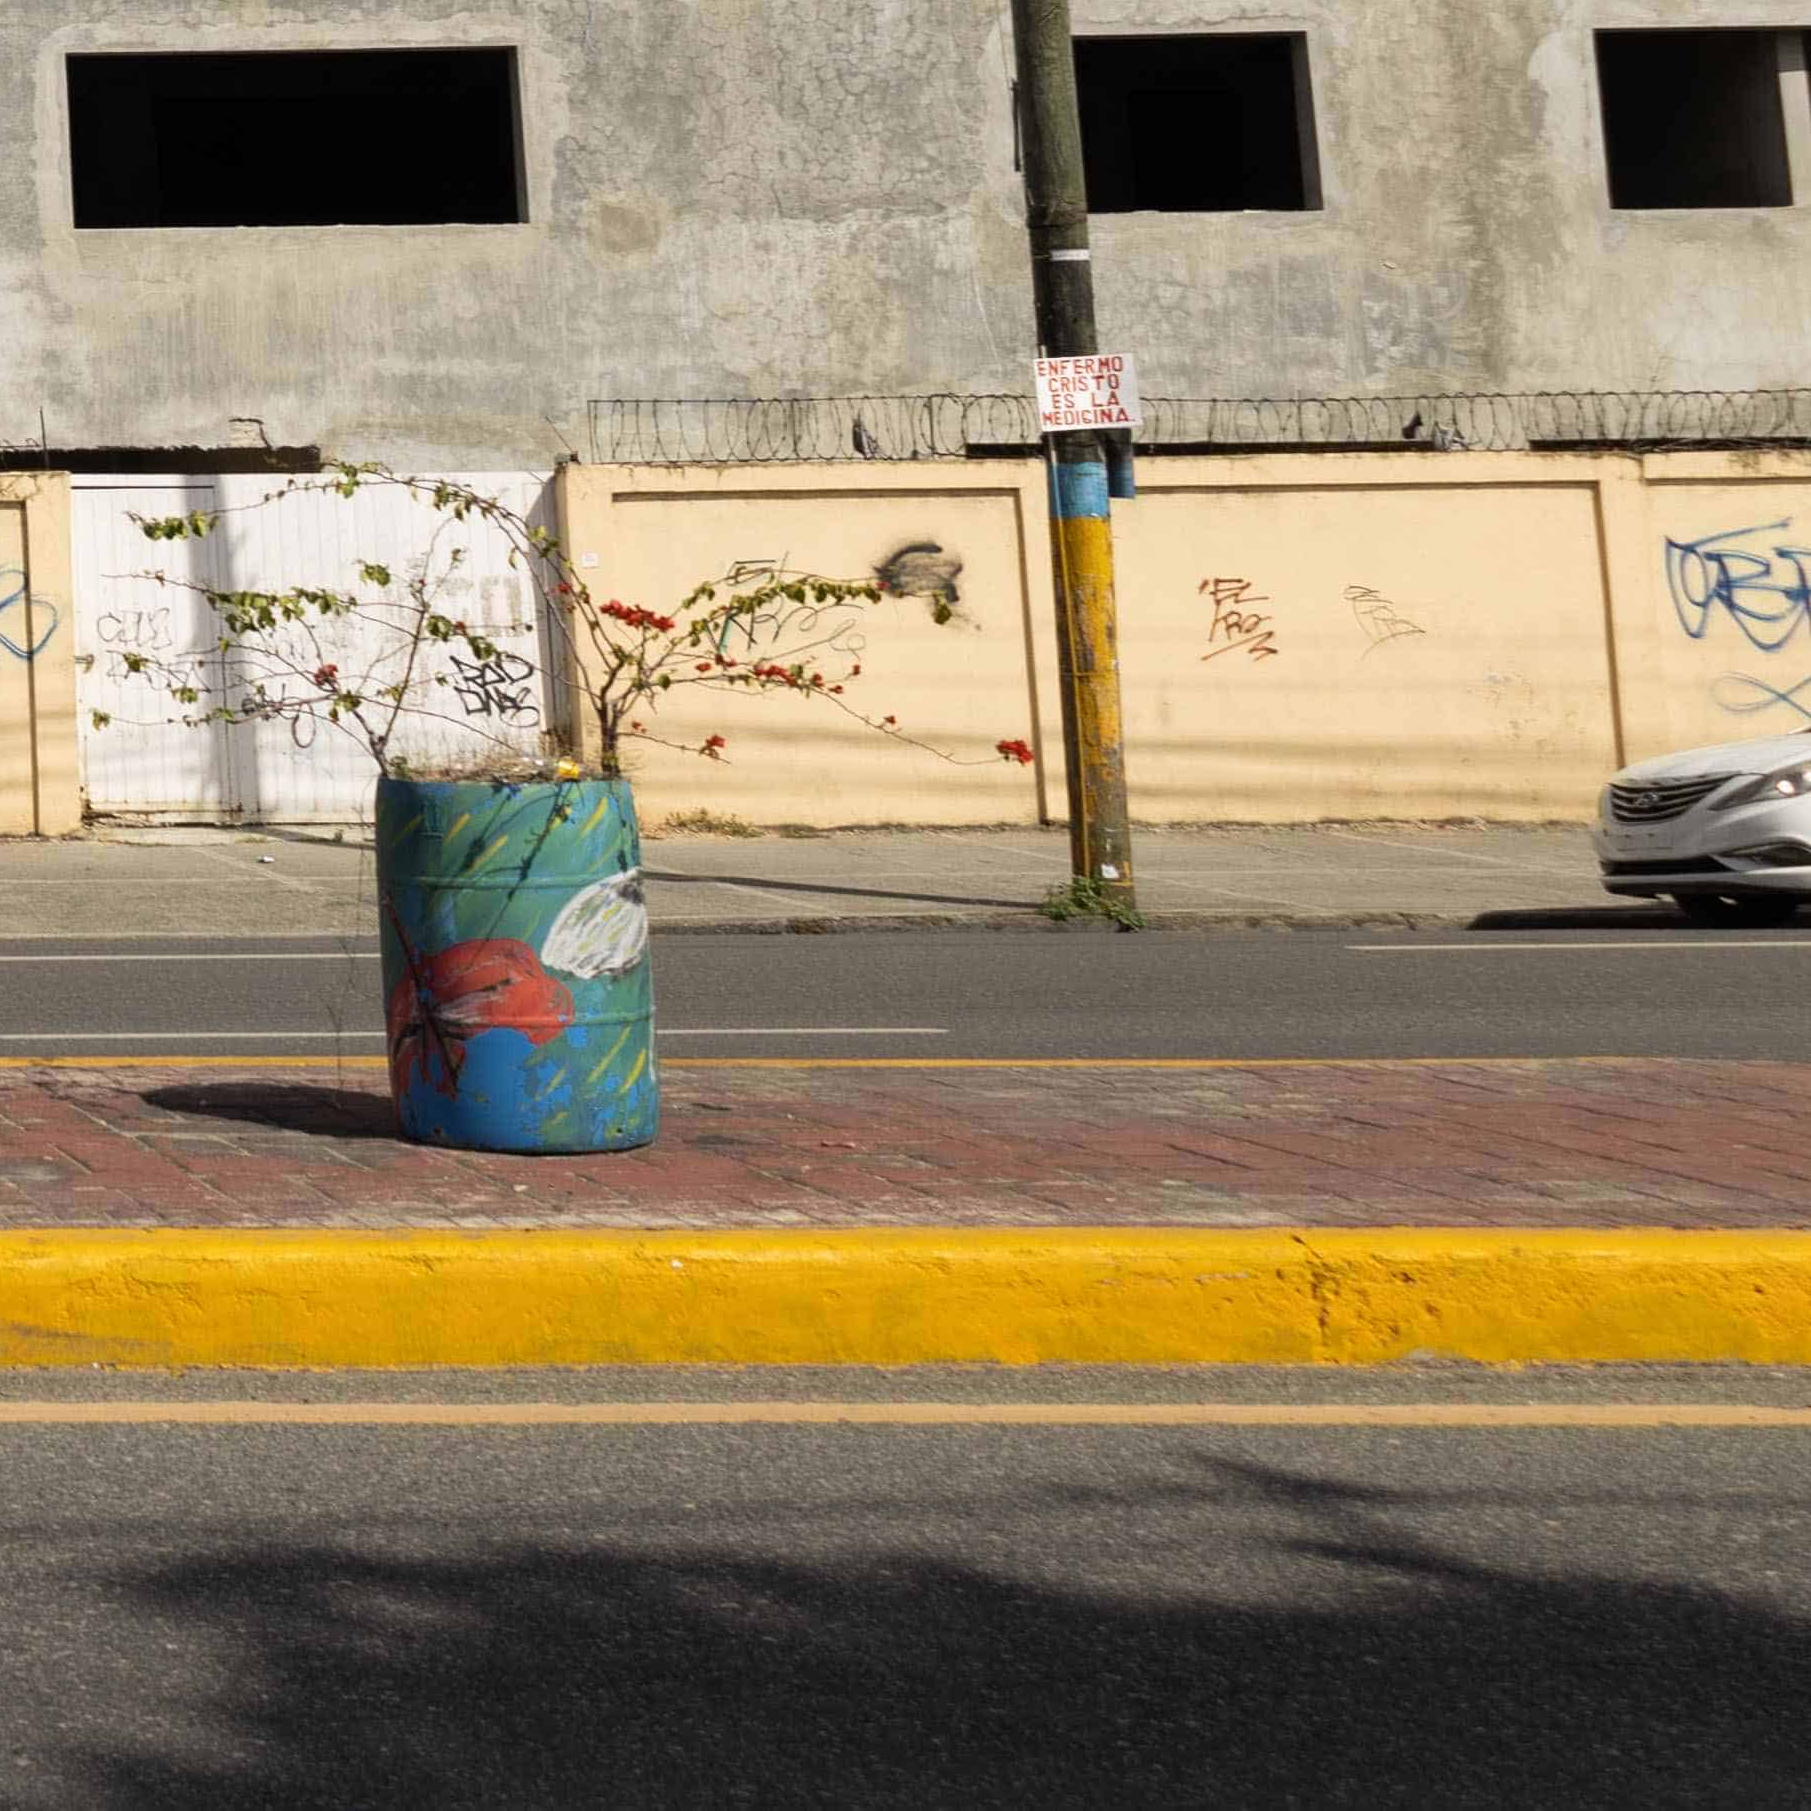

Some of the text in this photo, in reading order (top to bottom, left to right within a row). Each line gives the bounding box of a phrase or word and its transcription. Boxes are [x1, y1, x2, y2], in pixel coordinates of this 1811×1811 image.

[1037, 356, 1123, 376] ENFERMO
[1049, 374, 1119, 392] CRISTO
[1051, 392, 1119, 409] ES LA
